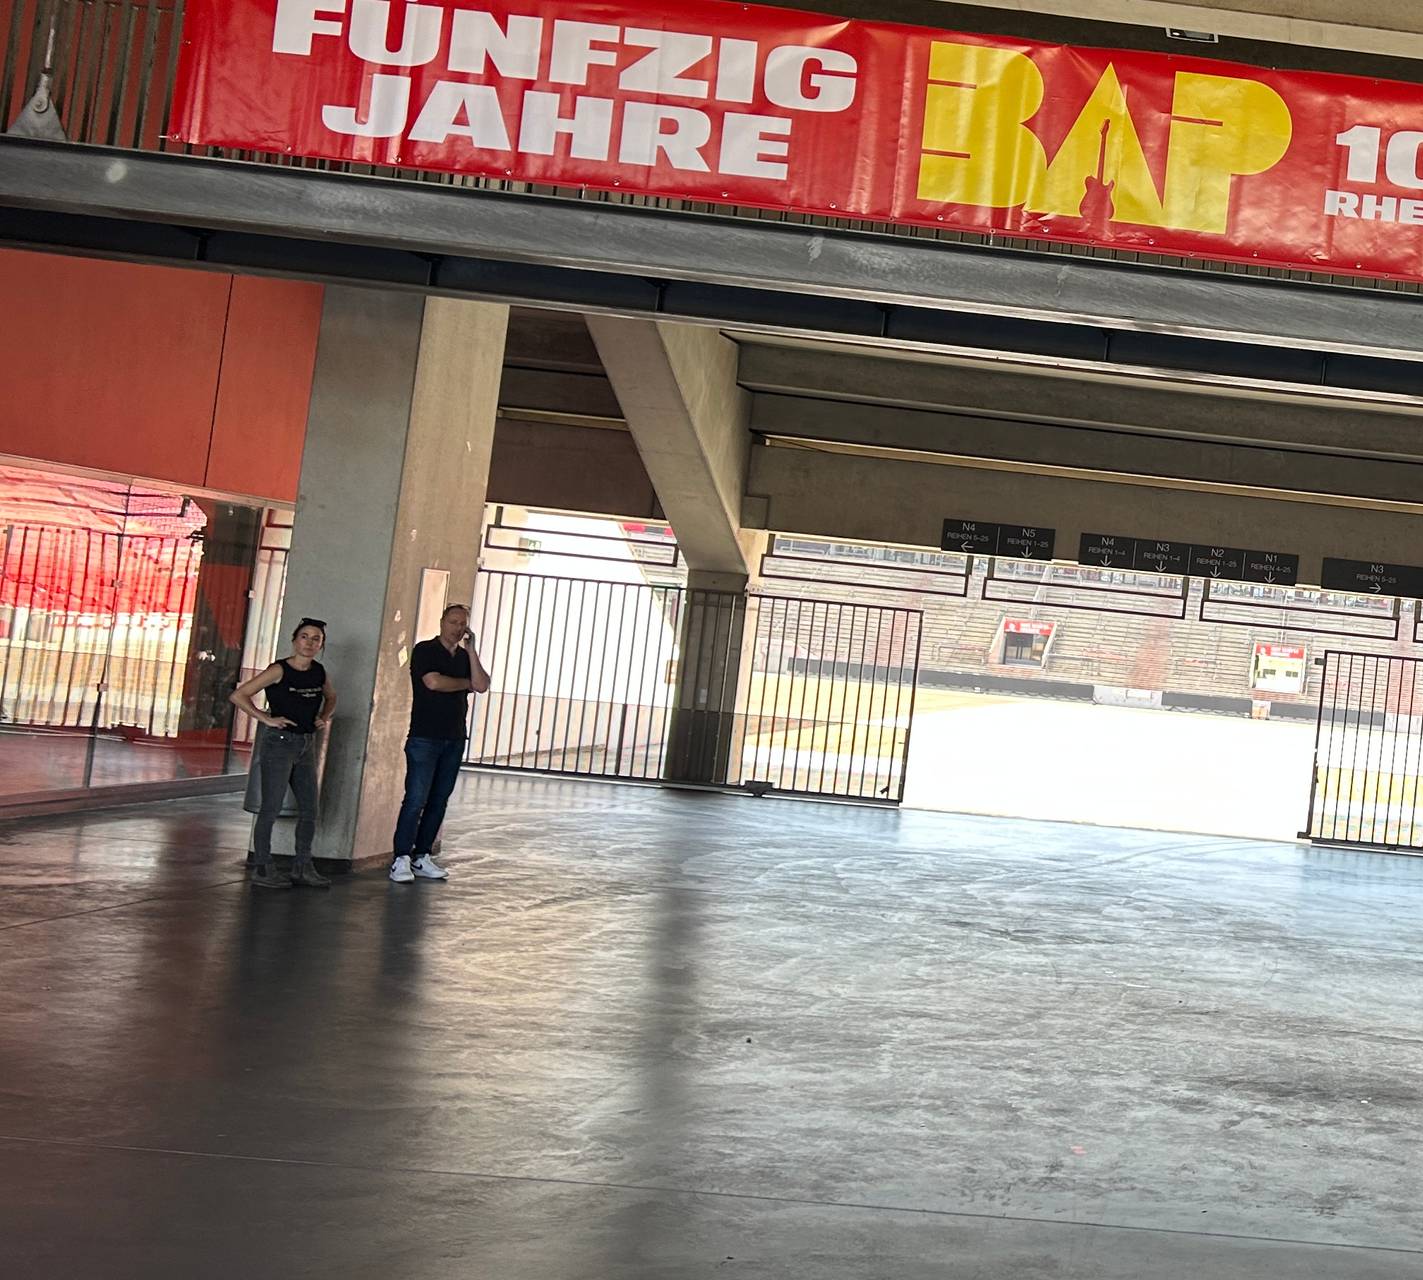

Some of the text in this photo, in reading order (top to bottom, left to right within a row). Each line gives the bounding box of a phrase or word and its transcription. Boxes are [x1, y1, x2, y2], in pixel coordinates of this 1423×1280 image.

[322, 73, 792, 180] JAHRE
[917, 40, 1293, 235] BAP
[962, 522, 976, 531] N4
[1022, 528, 1036, 538] N5
[1101, 537, 1115, 546] N4
[1156, 543, 1170, 552] N3
[1211, 548, 1225, 558] N2
[1265, 554, 1278, 563] N1
[1370, 564, 1384, 574] N3
